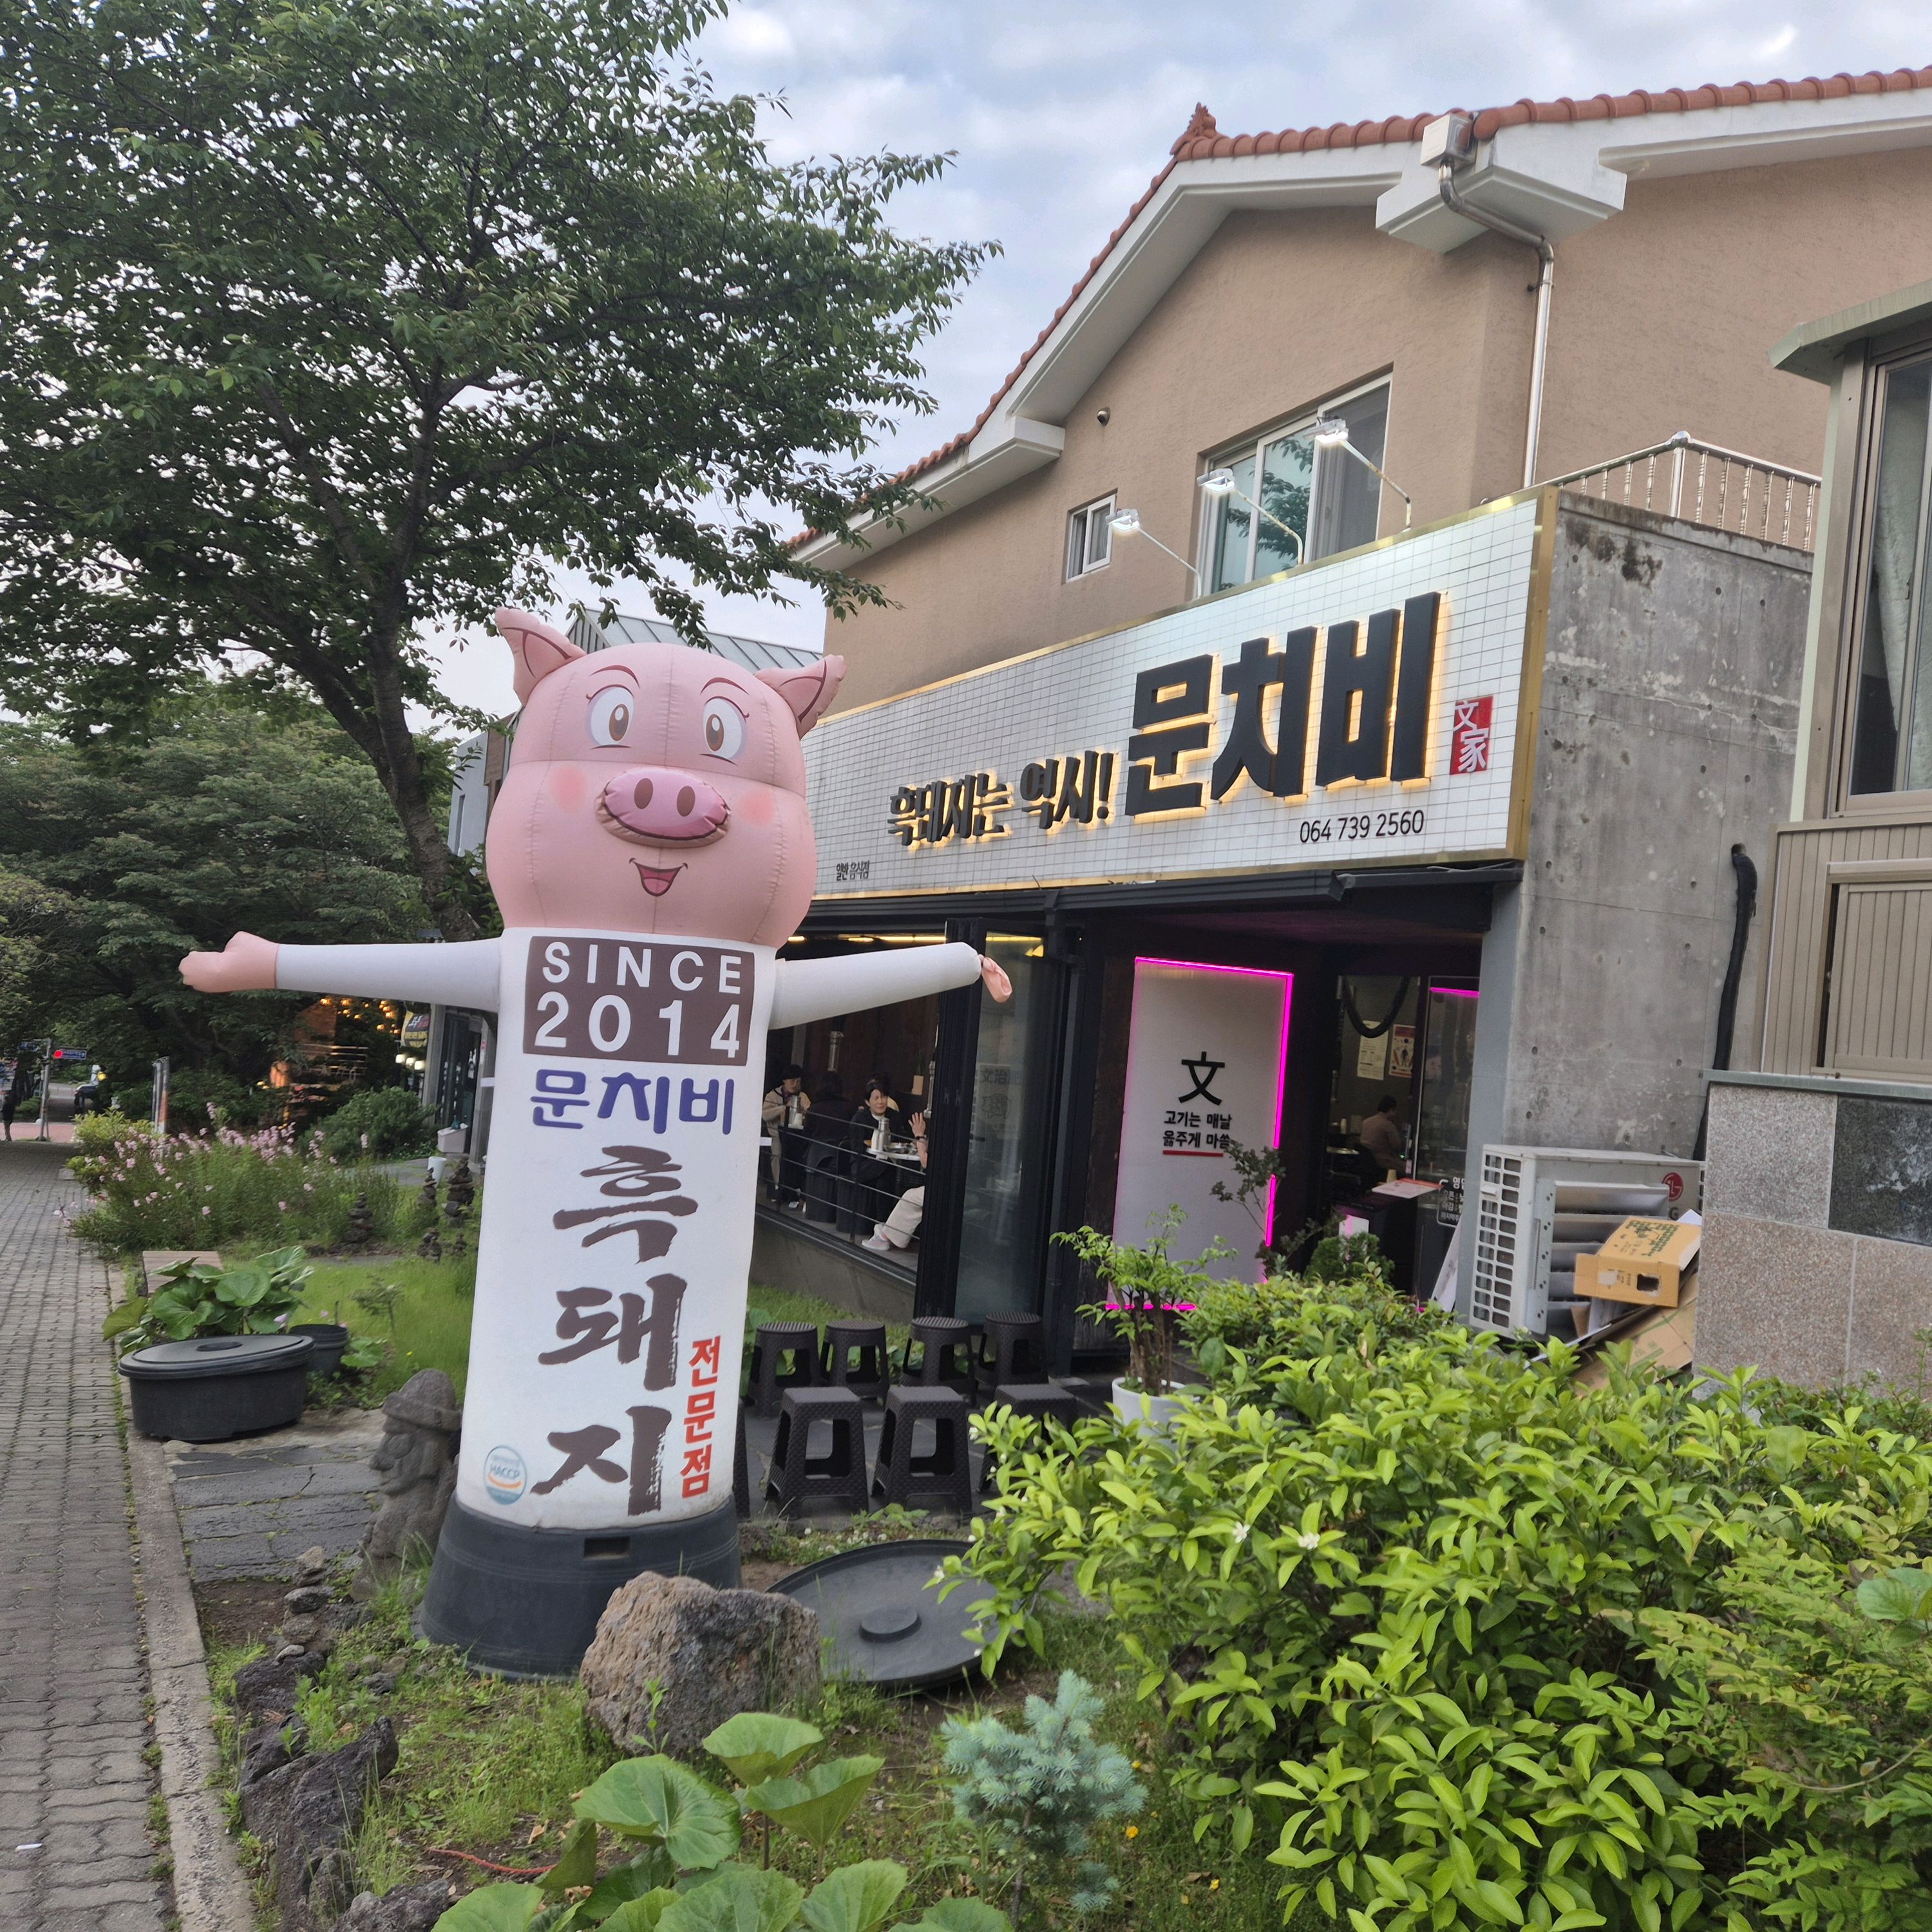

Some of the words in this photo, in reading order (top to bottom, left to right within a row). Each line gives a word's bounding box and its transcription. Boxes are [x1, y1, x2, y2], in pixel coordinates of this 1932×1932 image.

[887, 773, 1008, 846] 흑돼지는
[1020, 750, 1113, 829] 역시!
[1125, 591, 1441, 816] 문치비
[1453, 700, 1490, 772] 文家
[1300, 820, 1331, 844] 064
[1338, 815, 1370, 840] 739
[1376, 810, 1424, 837] 2560
[836, 862, 849, 881] 일반
[849, 860, 870, 880] 음식점
[542, 942, 741, 994] SINCE
[534, 991, 740, 1058] 2014
[530, 1069, 735, 1135] 문치비
[1179, 1051, 1225, 1106] 文
[1164, 1111, 1201, 1127] 고기는
[1206, 1113, 1233, 1130] 매날
[530, 1145, 699, 1516] 흑돼지
[680, 1335, 721, 1499] 전문점
